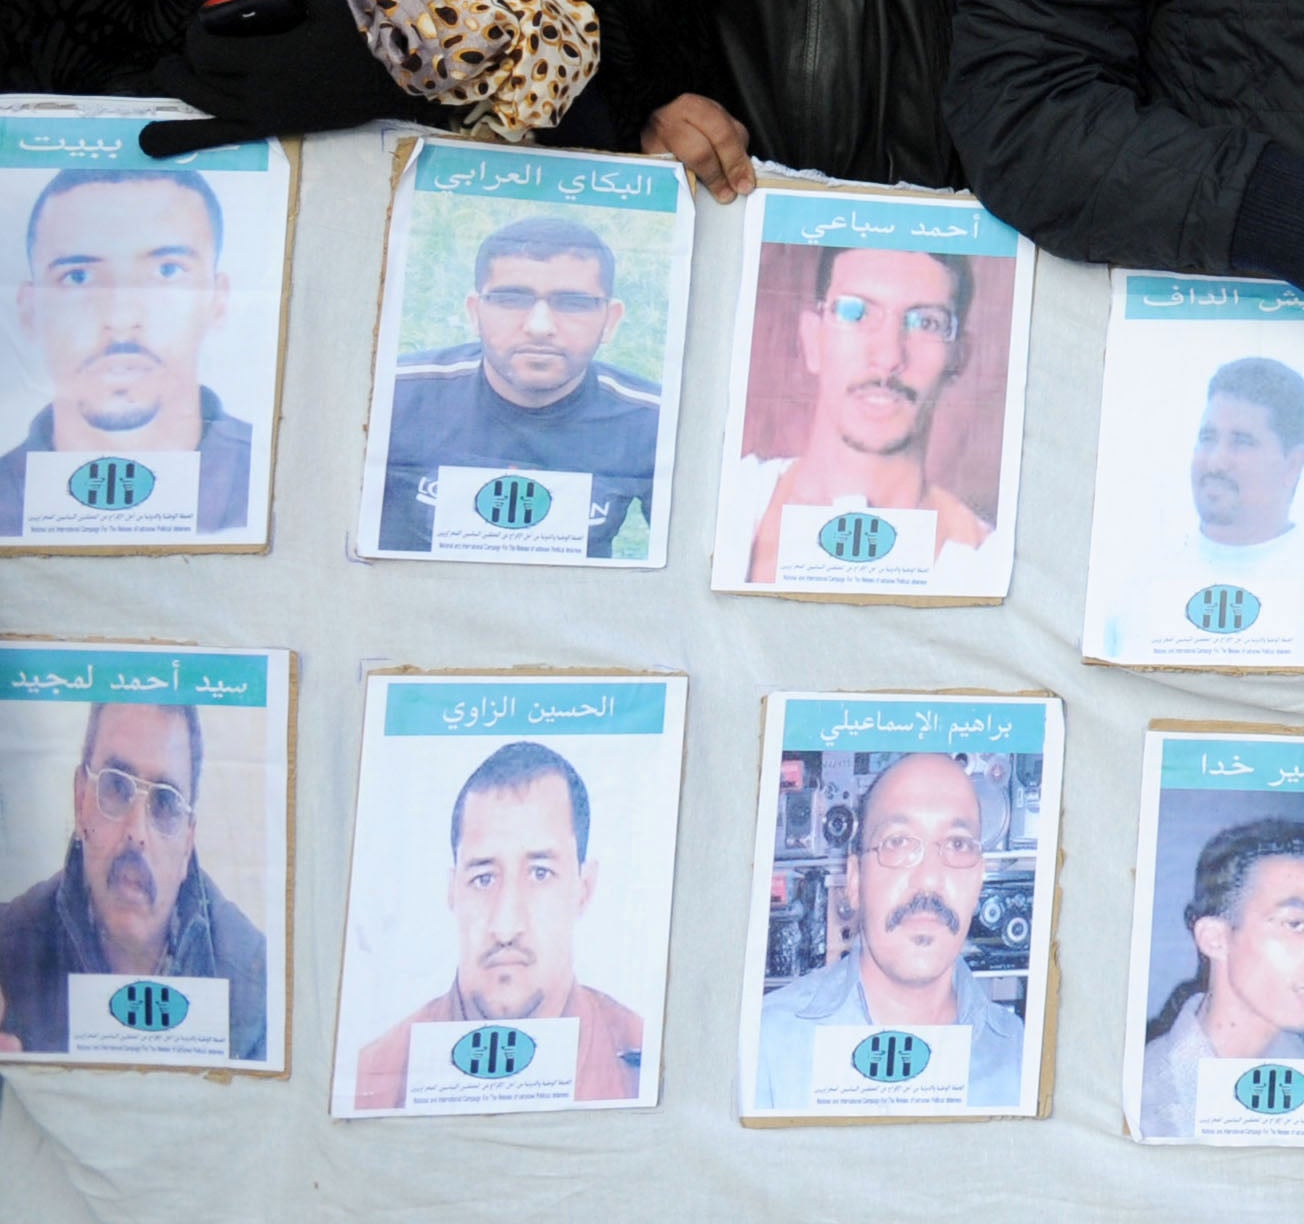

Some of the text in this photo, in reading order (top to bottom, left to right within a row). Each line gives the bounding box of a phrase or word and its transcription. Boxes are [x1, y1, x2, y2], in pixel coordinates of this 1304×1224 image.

[433, 159, 652, 201] البكاي العرابي
[801, 210, 980, 246] أحمد سباعي
[1143, 284, 1239, 308] الداف
[11, 658, 249, 699] سيد أحمد لمجيد
[442, 694, 615, 731] الحسين الزاوي
[948, 713, 1013, 746] براهيم
[1201, 752, 1255, 777] خدا
